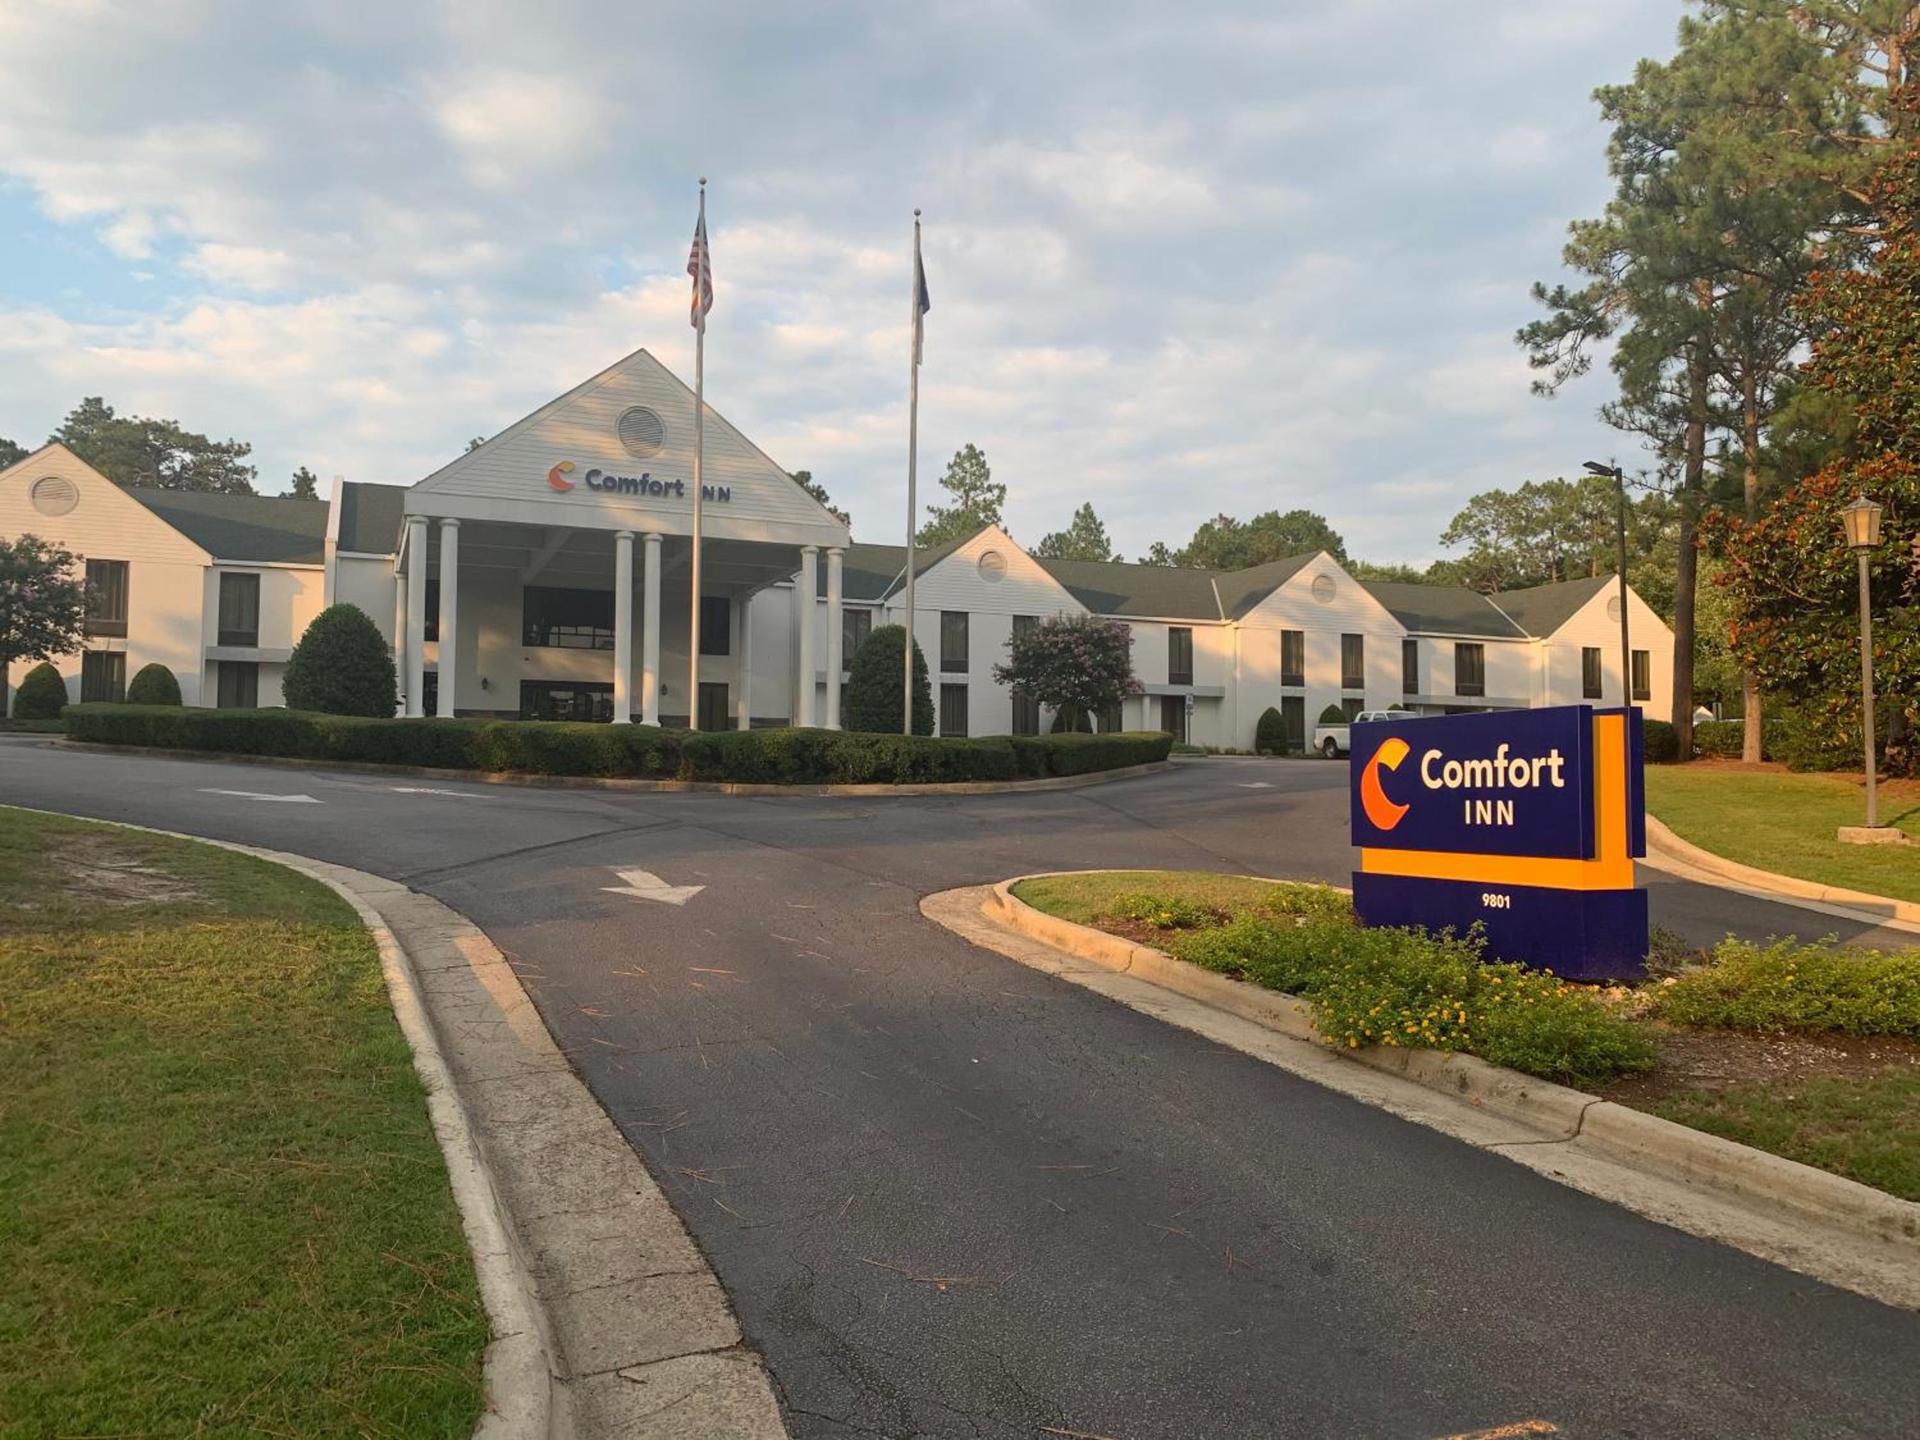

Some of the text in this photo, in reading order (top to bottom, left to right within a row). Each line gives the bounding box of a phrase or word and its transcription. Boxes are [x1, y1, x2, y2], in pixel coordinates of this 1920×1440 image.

[585, 469, 730, 502] Comfort NN
[1421, 743, 1565, 789] Comfort
[1465, 800, 1514, 825] INN
[1482, 893, 1510, 909] 9801
